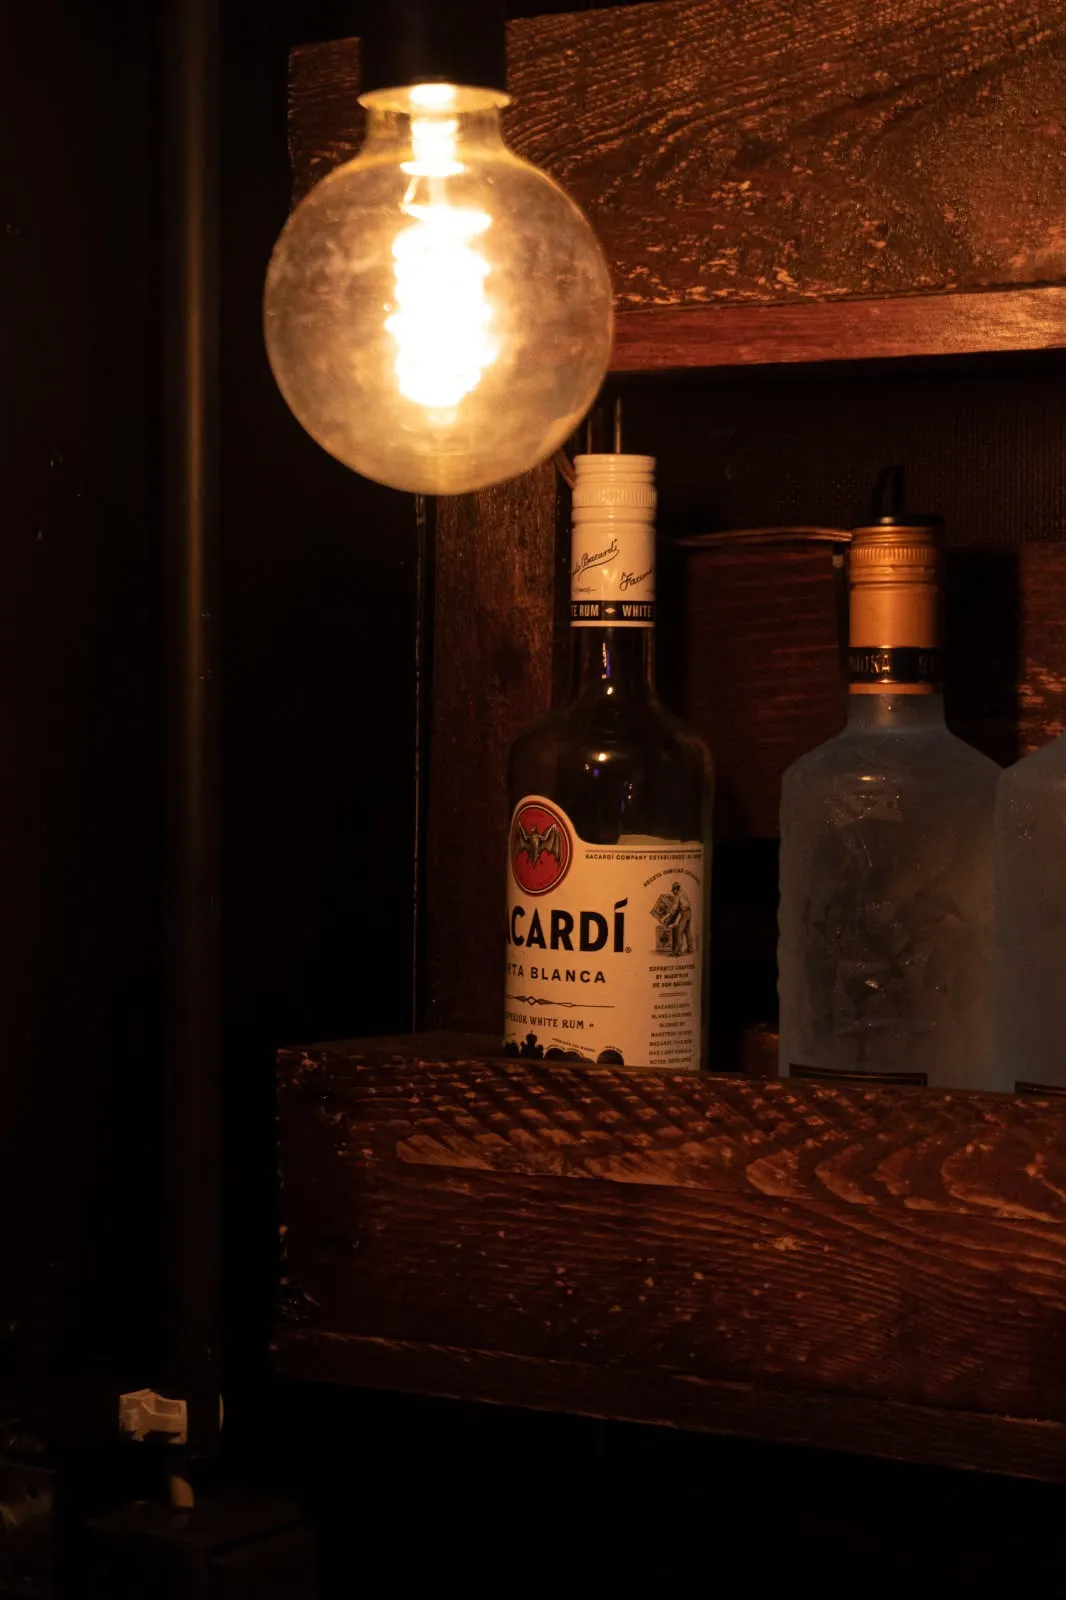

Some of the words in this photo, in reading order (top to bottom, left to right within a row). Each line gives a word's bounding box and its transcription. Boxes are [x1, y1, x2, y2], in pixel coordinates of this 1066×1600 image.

[579, 604, 599, 617] RUM
[622, 604, 652, 617] WHITE
[530, 966, 606, 984] BLANCA
[529, 1016, 558, 1028] WHITE
[562, 1019, 585, 1030] RUM
